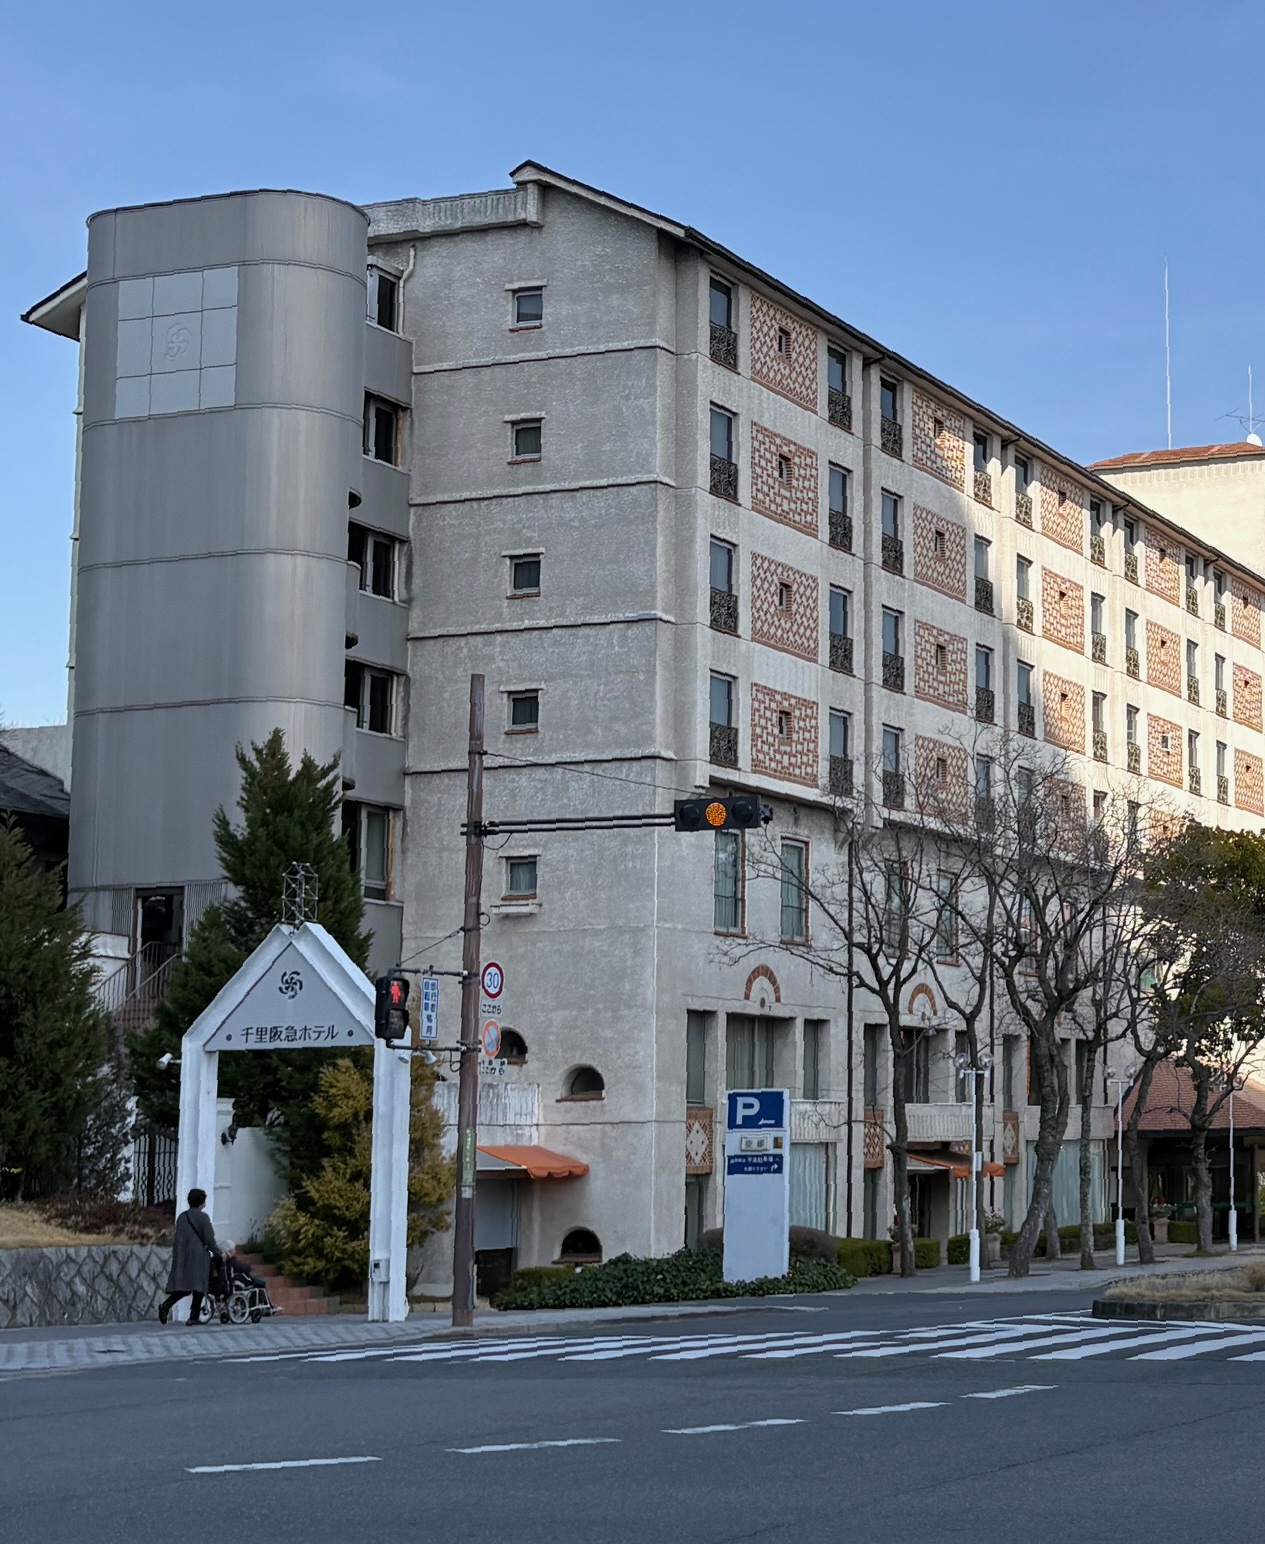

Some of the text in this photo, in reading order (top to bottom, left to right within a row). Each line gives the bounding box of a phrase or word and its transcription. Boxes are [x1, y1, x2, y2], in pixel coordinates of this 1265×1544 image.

[486, 971, 500, 989] 30
[481, 1003, 502, 1015] ここから
[241, 1024, 339, 1043] 千里阪急ホテル
[736, 1097, 760, 1125] P
